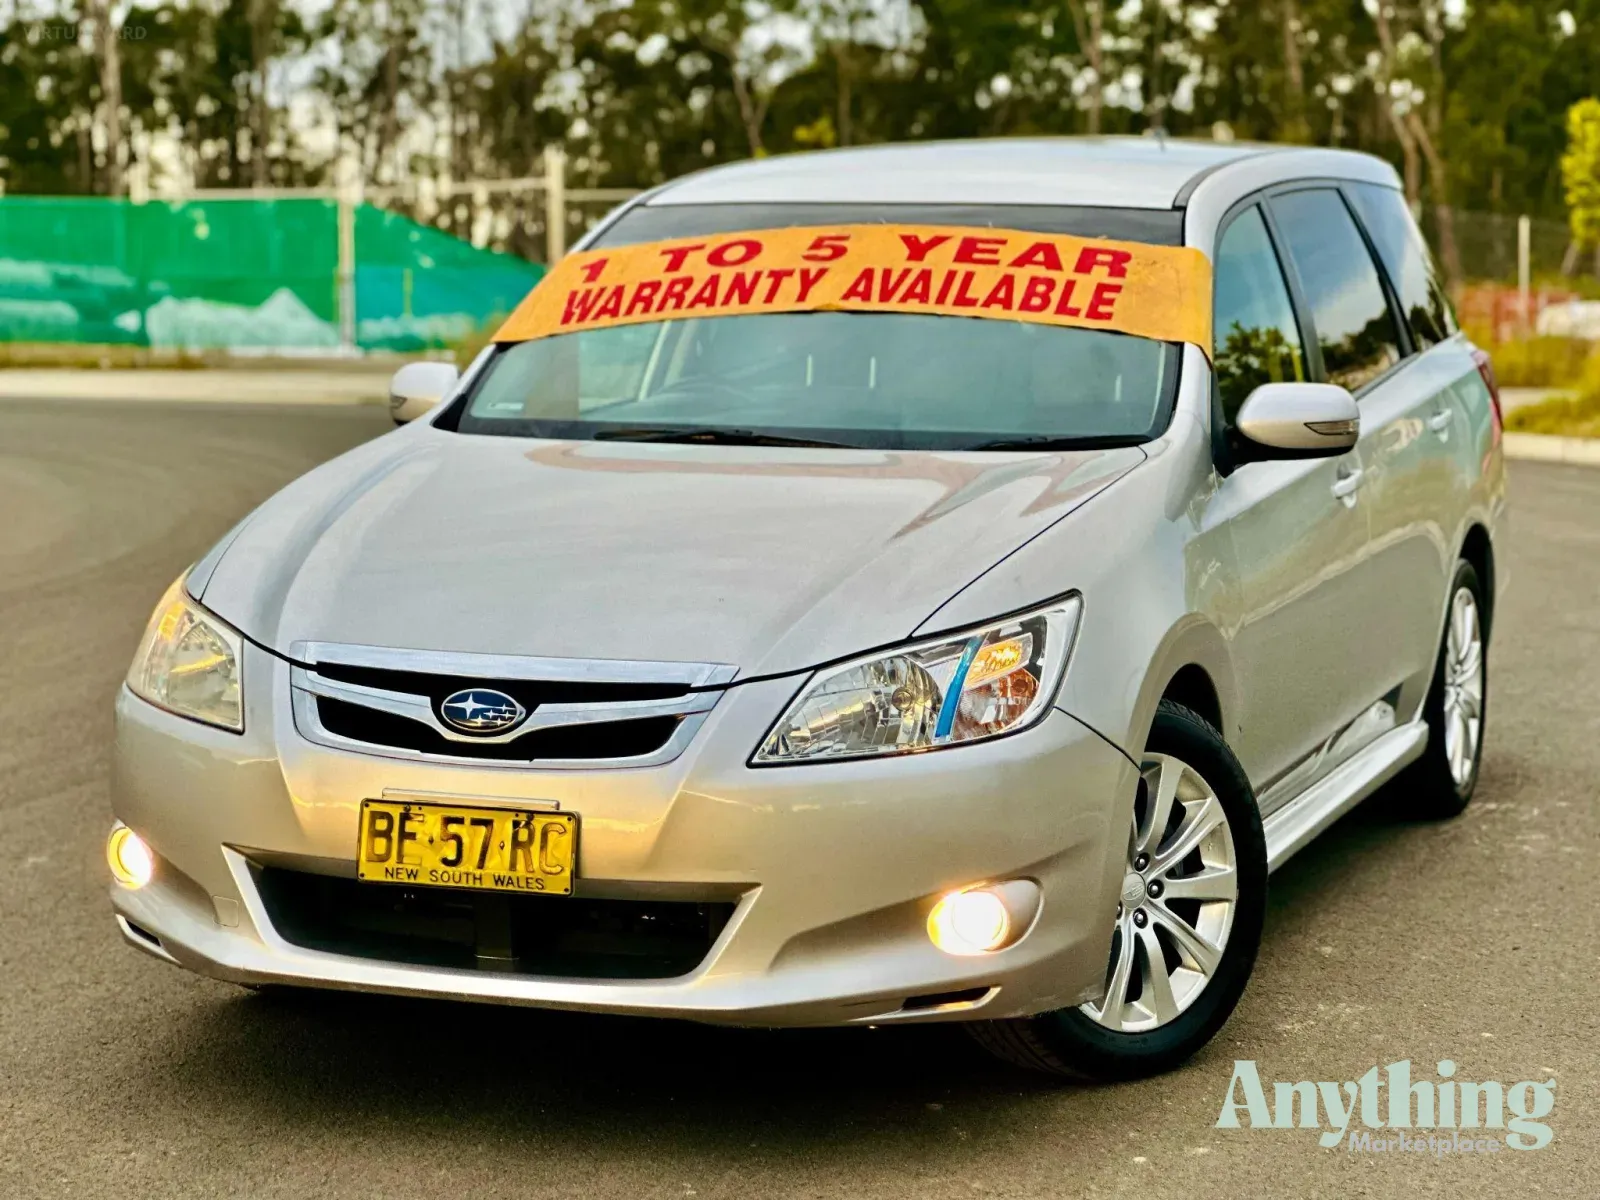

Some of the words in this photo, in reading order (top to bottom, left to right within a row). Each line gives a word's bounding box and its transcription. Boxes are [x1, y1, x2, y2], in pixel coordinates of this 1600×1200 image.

[580, 258, 609, 283] 1
[660, 240, 763, 273] TO
[802, 235, 851, 262] 5
[898, 234, 1132, 278] YEAR
[560, 268, 828, 325] WARRANTY
[840, 267, 1123, 321] AVAILABLE
[440, 815, 494, 870] 57
[508, 819, 567, 876] RC
[384, 866, 419, 881] NEW
[429, 870, 483, 886] SOUTH
[493, 874, 545, 890] WALES
